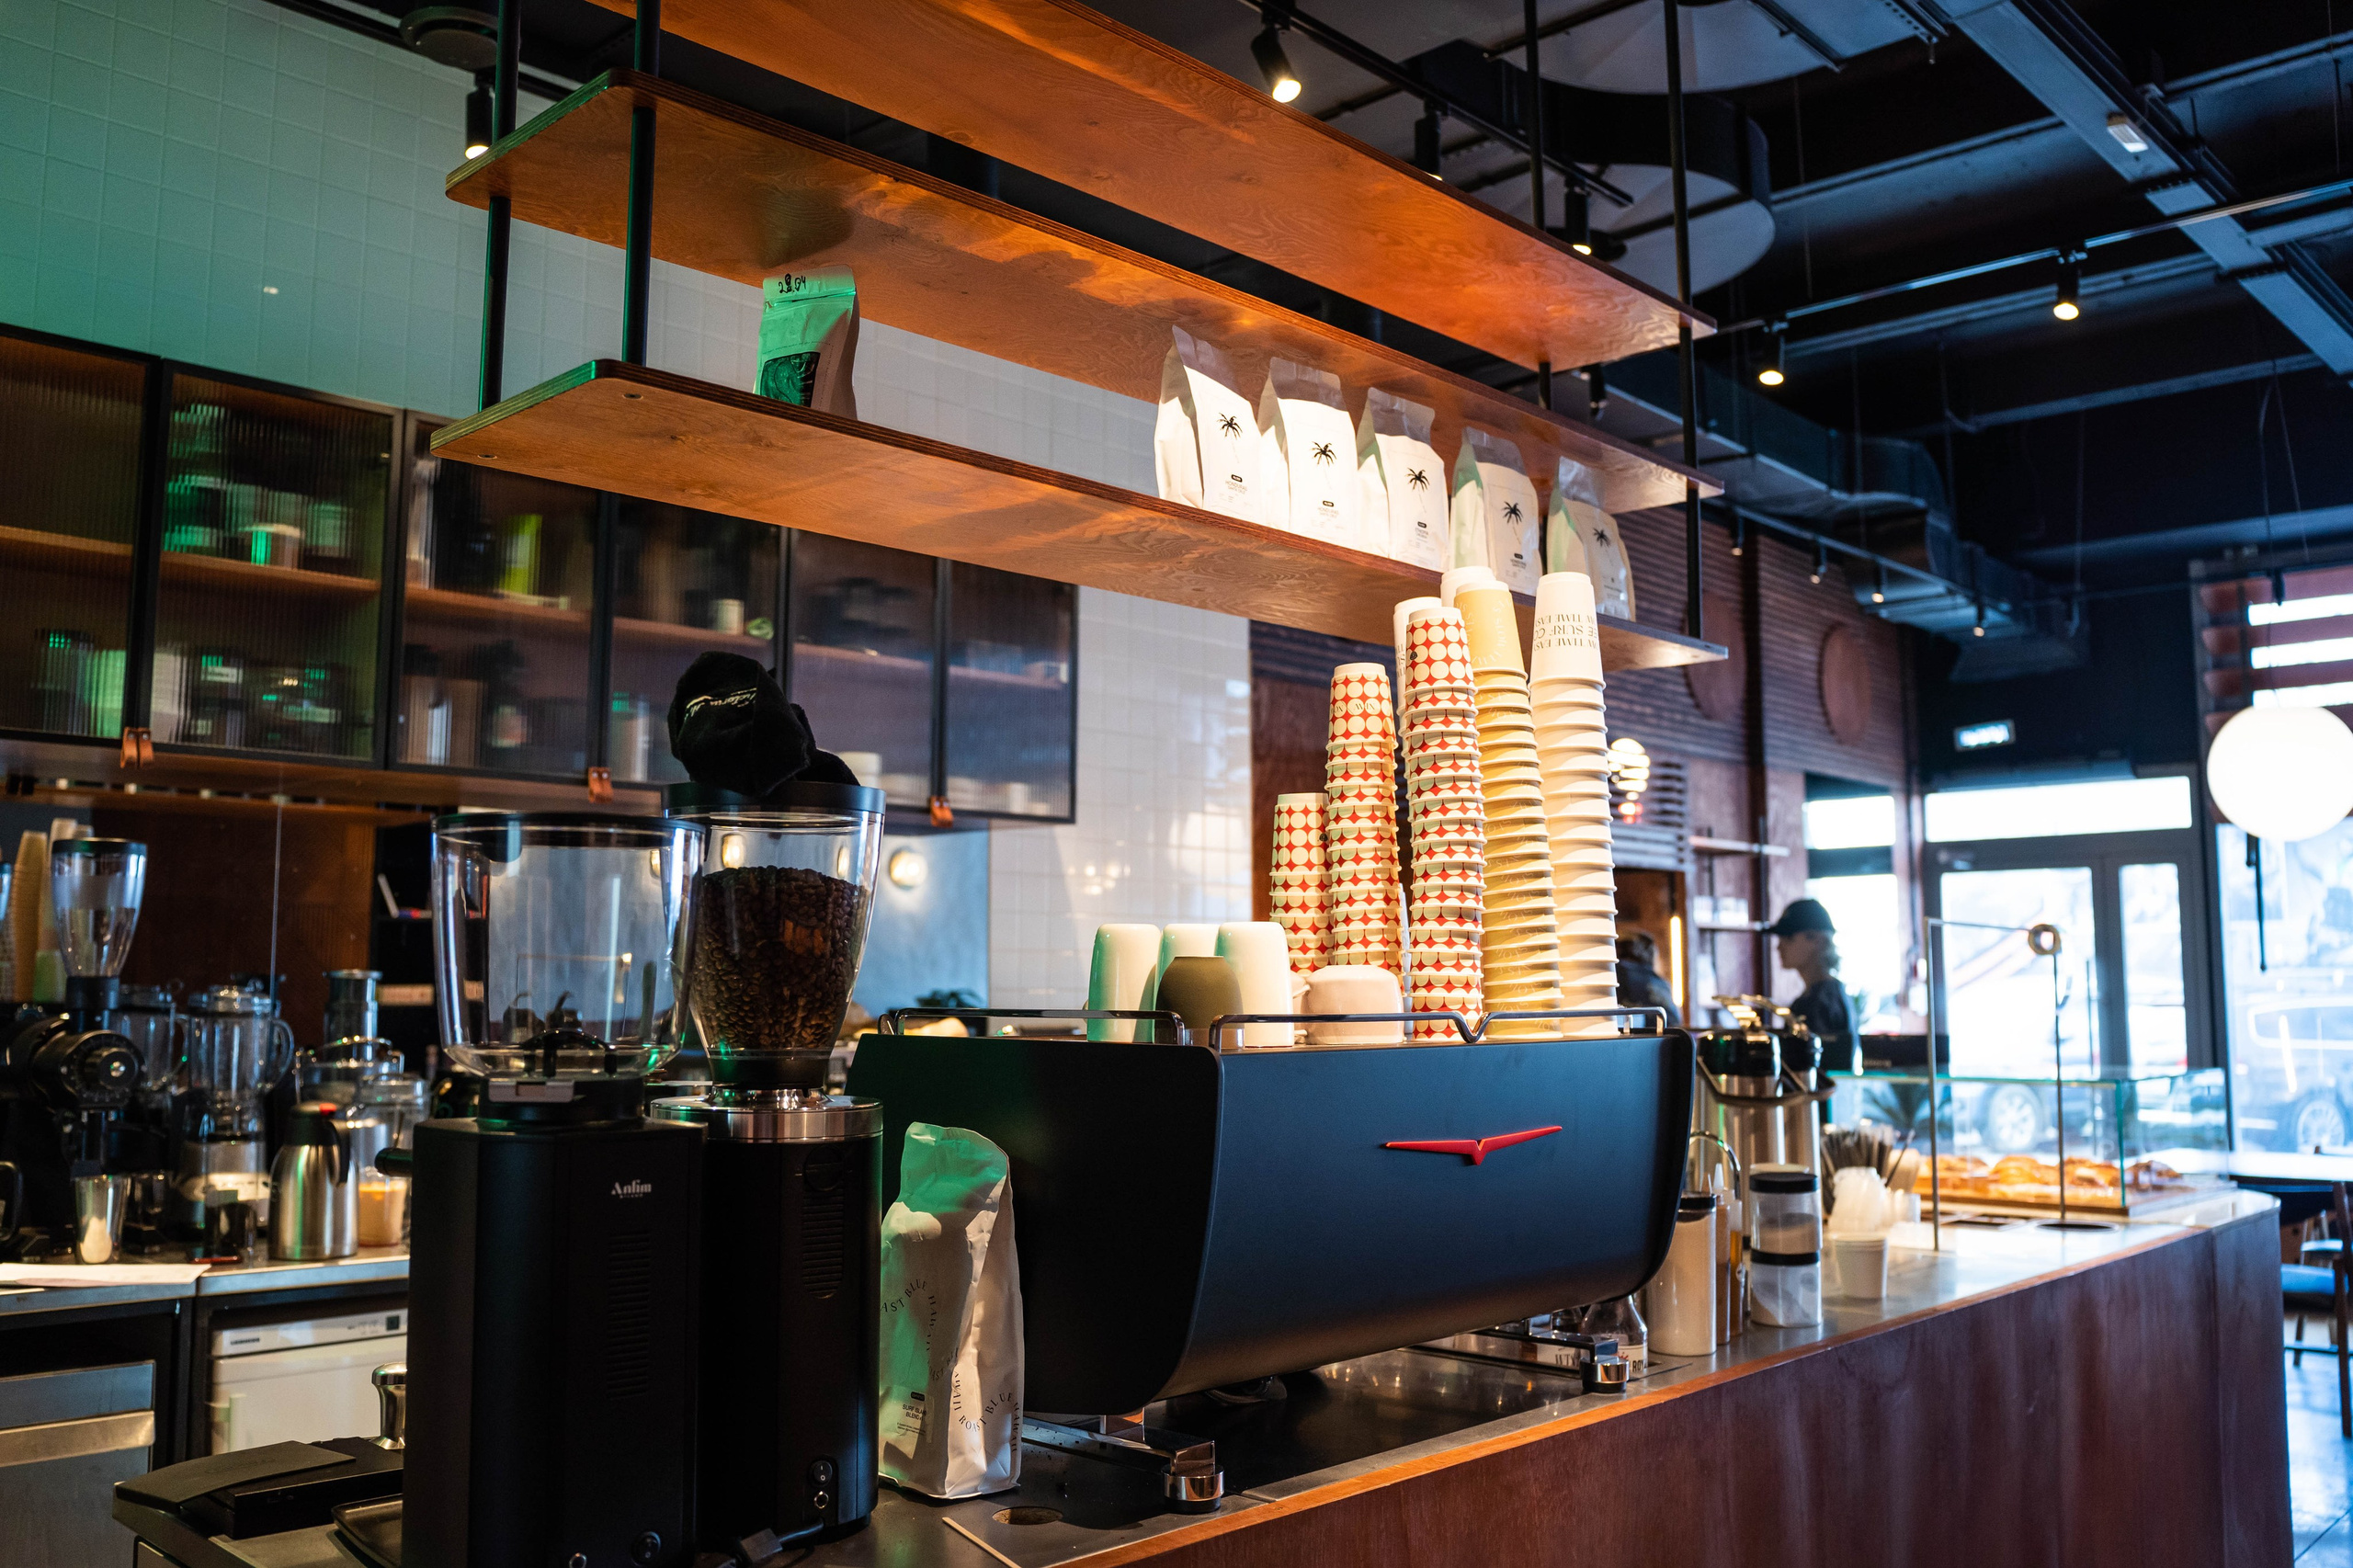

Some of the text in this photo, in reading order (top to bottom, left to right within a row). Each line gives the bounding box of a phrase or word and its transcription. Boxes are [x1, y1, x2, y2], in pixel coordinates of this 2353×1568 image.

[1549, 624, 1584, 636] SURF
[611, 1179, 652, 1195] Anfim
[904, 1278, 927, 1298] BLUE
[958, 1414, 988, 1433] ROAST
[984, 1392, 1013, 1415] BLUE
